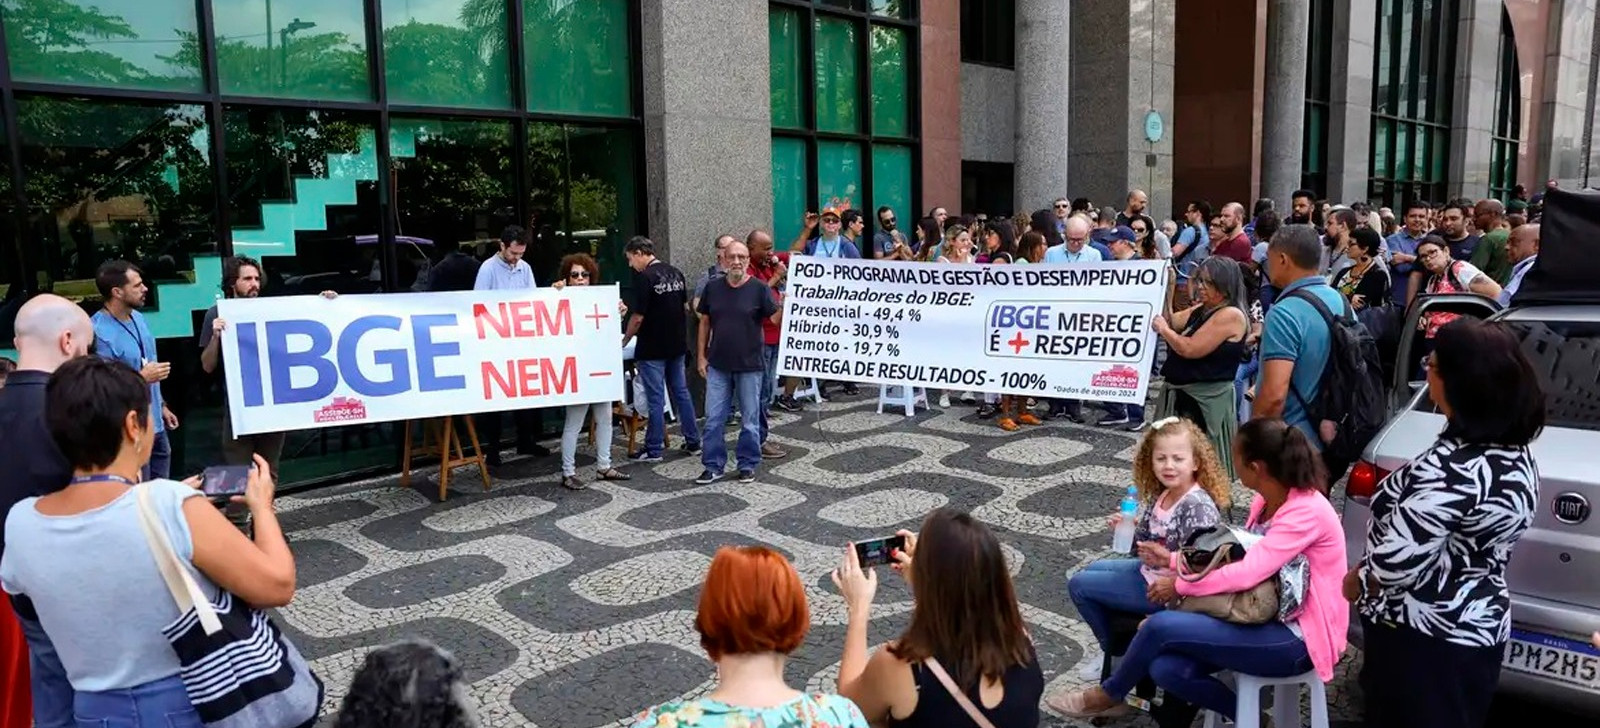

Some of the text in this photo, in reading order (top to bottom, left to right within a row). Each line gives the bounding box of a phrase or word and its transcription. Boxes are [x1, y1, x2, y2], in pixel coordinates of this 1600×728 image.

[794, 263, 824, 278] PGD
[834, 265, 917, 284] PROGRAMA
[920, 270, 940, 285] DE
[943, 268, 1010, 286] GESTÃO
[1013, 271, 1024, 286] E
[1026, 269, 1156, 286] DESEMPENHO
[793, 284, 974, 306] Trabalhadores do IBGE:
[473, 300, 574, 340] NEM
[790, 304, 860, 319] Presencial
[873, 308, 904, 322] 49,4
[908, 308, 922, 322] %
[991, 305, 1144, 333] IBGE MERECE
[788, 320, 840, 335] Híbrido
[853, 324, 882, 339] 30,9
[886, 325, 900, 338] %
[786, 336, 840, 352] Remoto
[854, 341, 884, 356] 19,7
[887, 343, 900, 357] %
[990, 330, 1000, 352] É
[1034, 334, 1142, 358] RESPEITO
[236, 314, 466, 407] IBGE
[784, 356, 850, 375] ENTREGA
[854, 360, 876, 377] DE
[878, 363, 986, 386] RESULTADOS
[1000, 372, 1047, 390] 100%
[480, 356, 578, 400] NEM
[1560, 503, 1582, 518] FIAT
